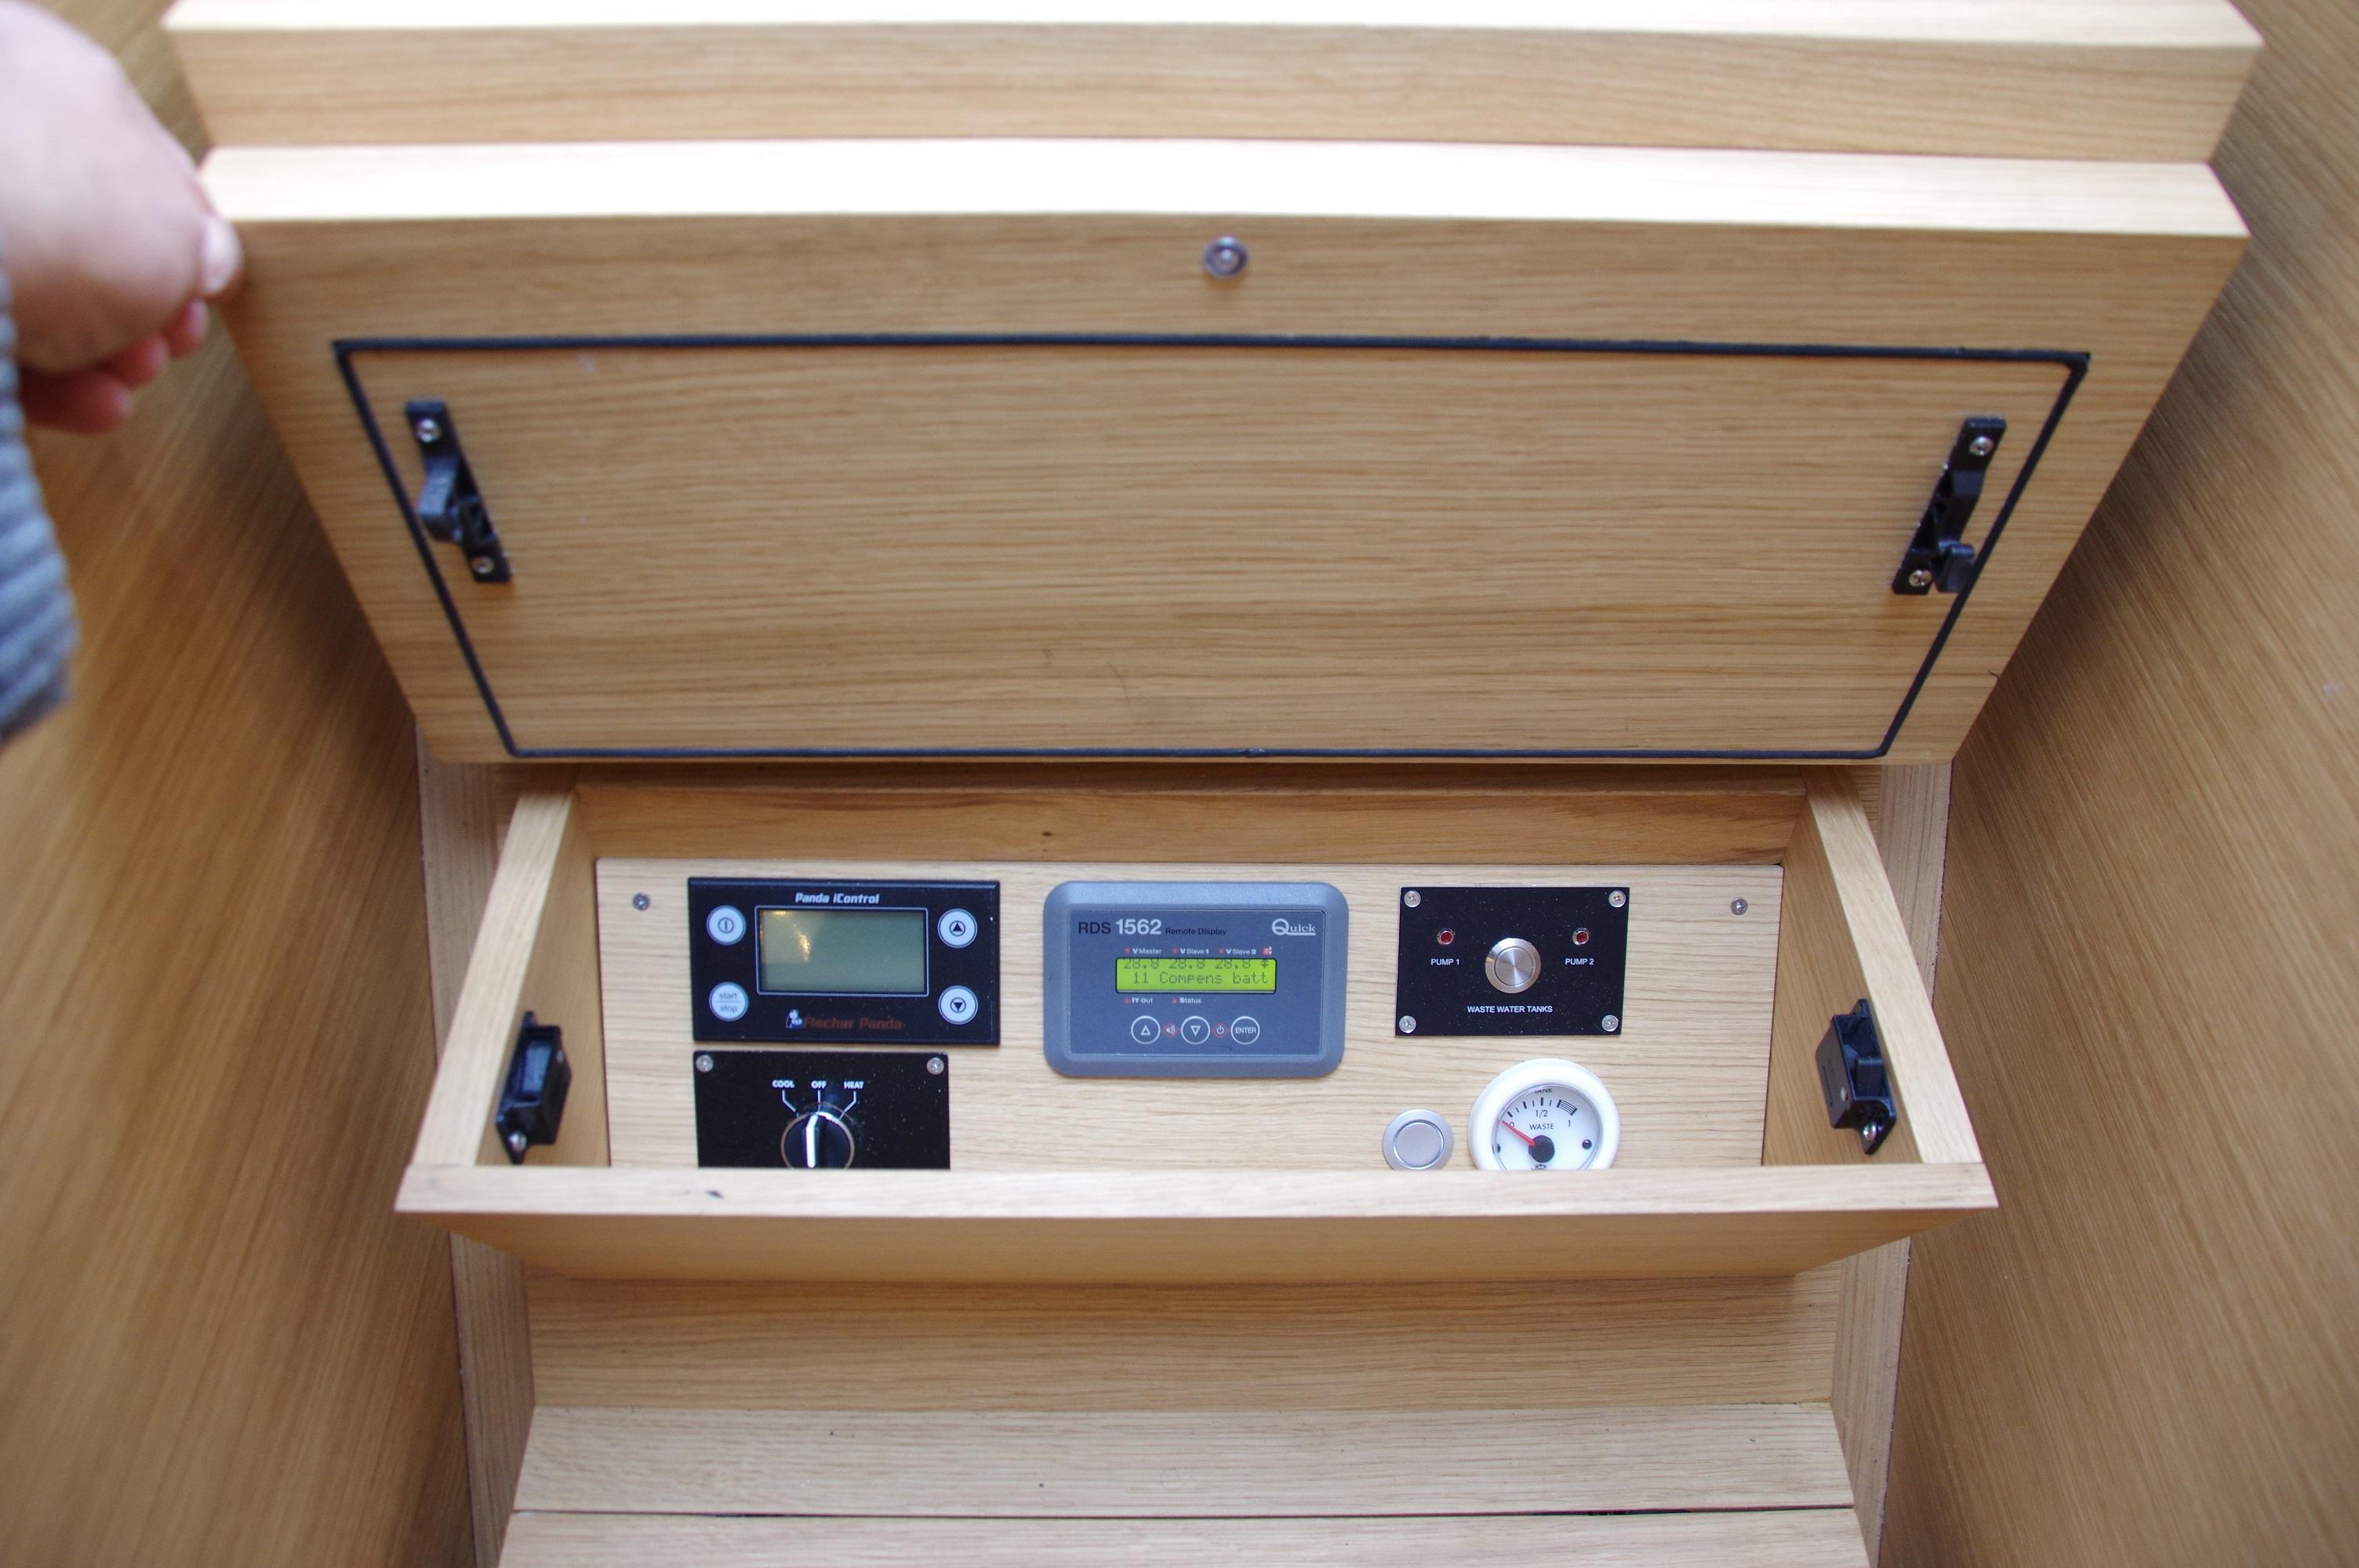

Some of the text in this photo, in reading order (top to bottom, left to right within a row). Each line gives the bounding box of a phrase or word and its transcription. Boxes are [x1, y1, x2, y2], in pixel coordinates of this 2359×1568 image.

[795, 892, 879, 904] Panda iControl
[1078, 921, 1111, 935] RDS
[1116, 918, 1162, 935] 1562
[1198, 927, 1227, 936] Display
[1271, 918, 1316, 936] Quick
[1124, 959, 1251, 969] 28.8 28.8 28.8
[1133, 971, 1269, 985] 11 Compens batt
[720, 1004, 738, 1014] stop
[803, 1017, 902, 1029] Fischer Panda
[772, 1080, 794, 1088] COOL
[811, 1080, 827, 1089] OFF
[844, 1080, 863, 1089] HEAT
[1535, 1109, 1548, 1119] 1/2
